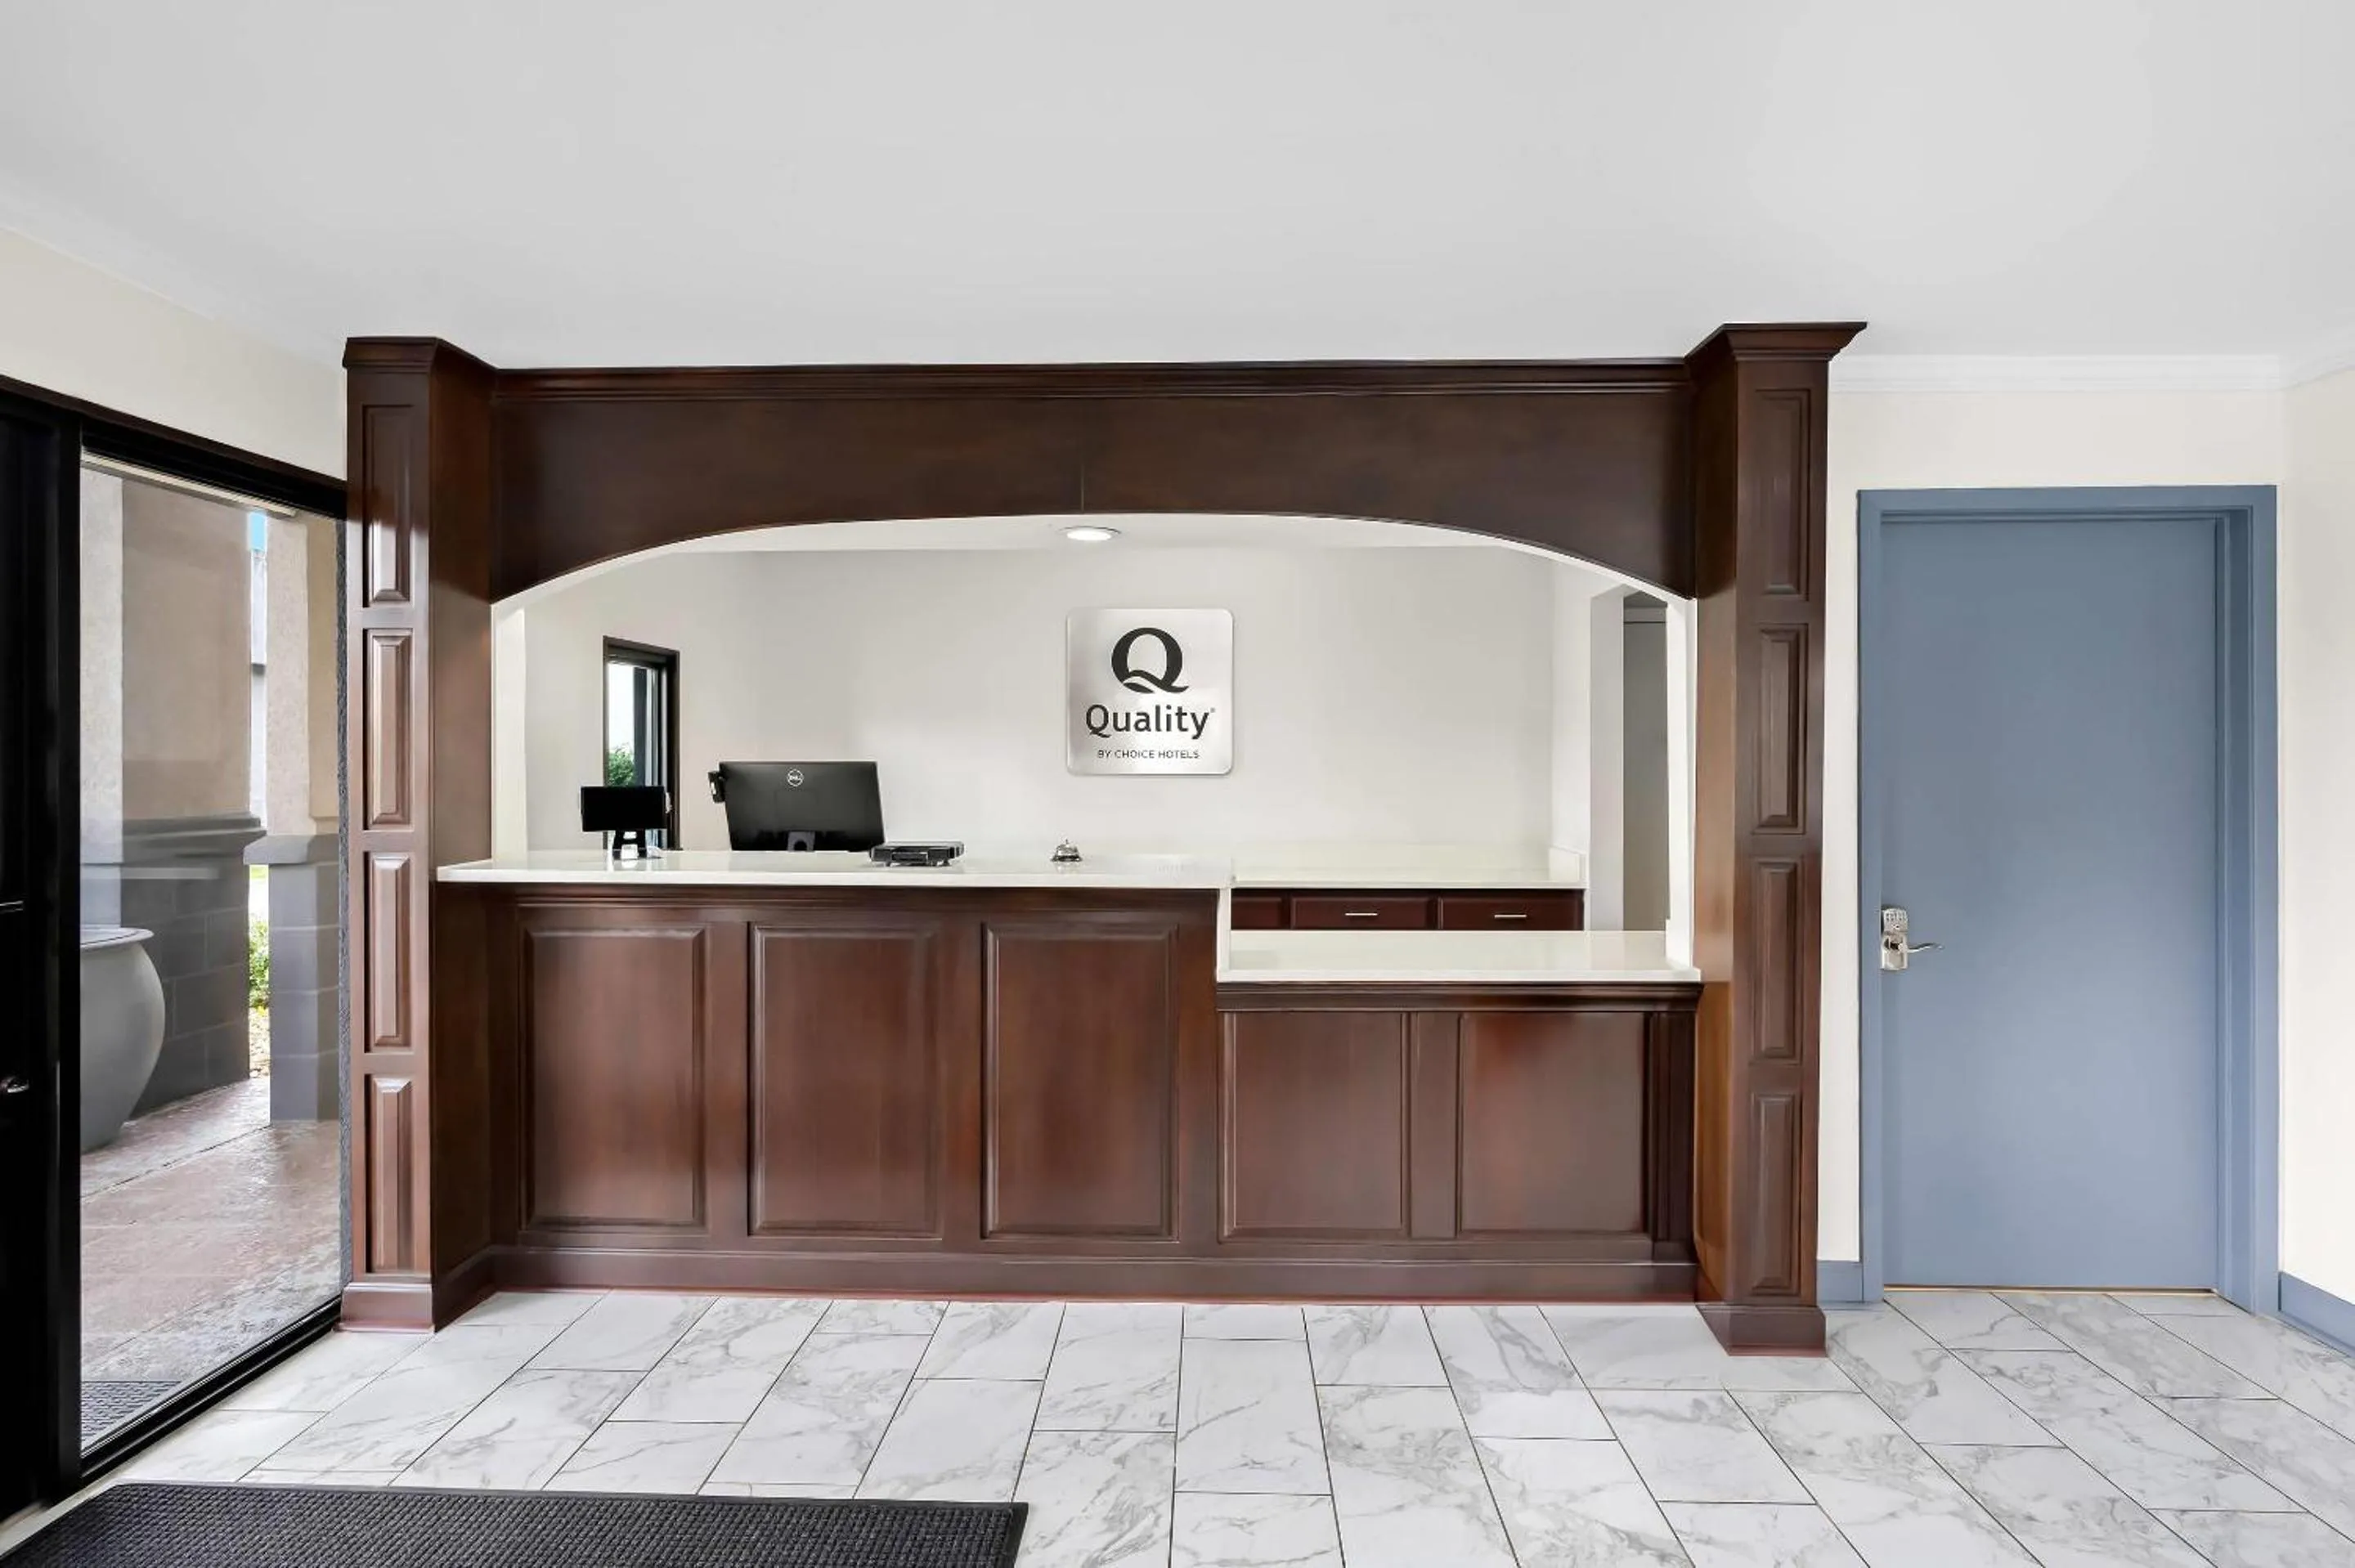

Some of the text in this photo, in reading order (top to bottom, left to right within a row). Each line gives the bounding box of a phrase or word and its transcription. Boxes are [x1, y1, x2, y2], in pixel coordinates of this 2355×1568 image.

[1110, 627, 1189, 694] Q
[1085, 704, 1209, 740] Quality
[1097, 749, 1200, 759] BY CHOICE HOTELS
